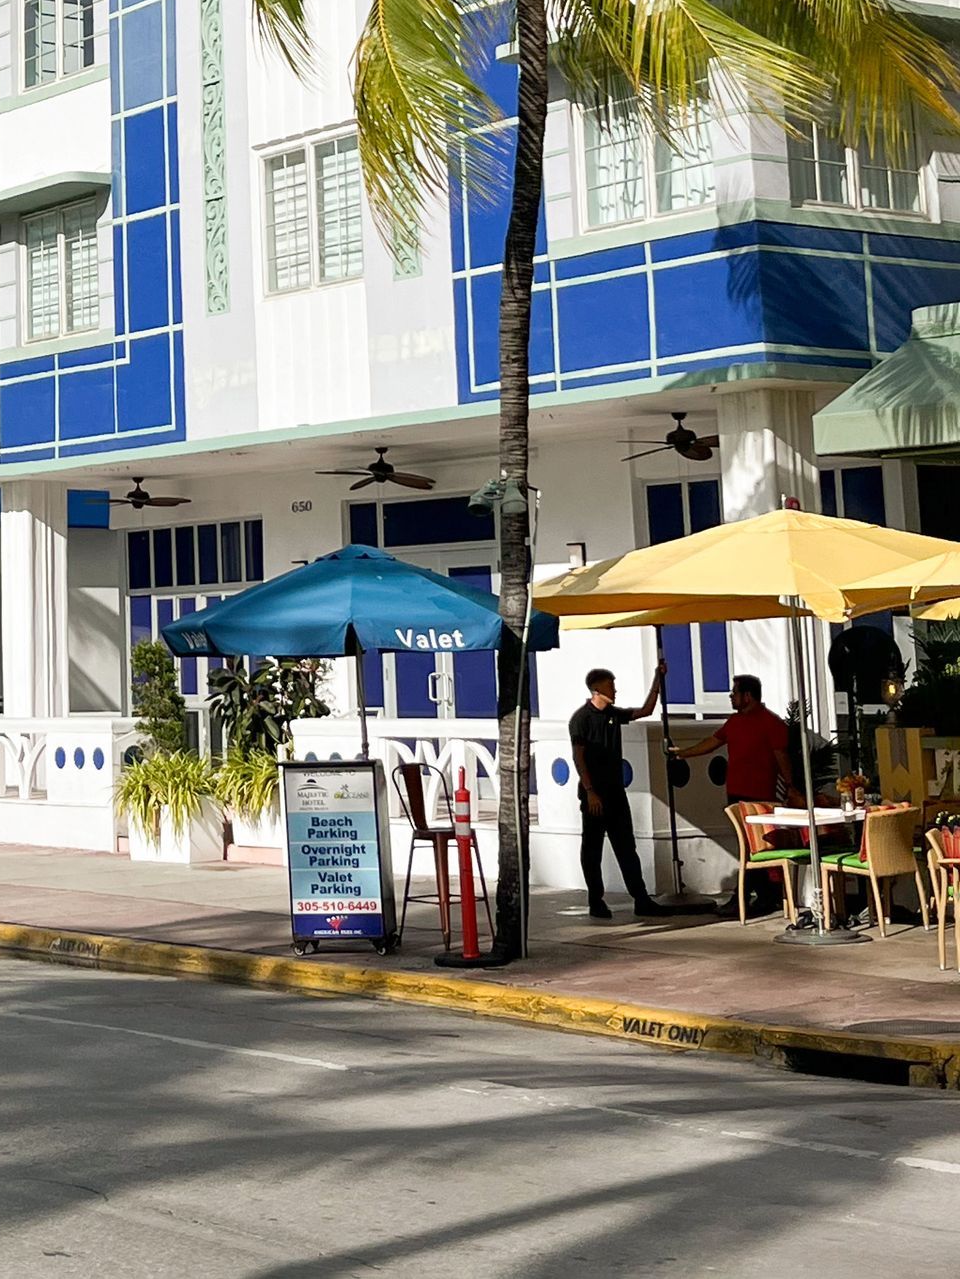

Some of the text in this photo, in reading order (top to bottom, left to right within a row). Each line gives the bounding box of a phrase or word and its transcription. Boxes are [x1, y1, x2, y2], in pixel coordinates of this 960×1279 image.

[291, 500, 313, 513] 650
[395, 627, 466, 651] Valet
[311, 816, 353, 827] Beach
[307, 828, 358, 840] Parking
[301, 844, 366, 857] Overnight
[309, 855, 360, 868] Parking
[318, 872, 353, 882] Valet
[311, 884, 361, 896] Parking
[297, 901, 377, 912] 305-510-6449
[623, 1017, 709, 1044] VALET ONLY
